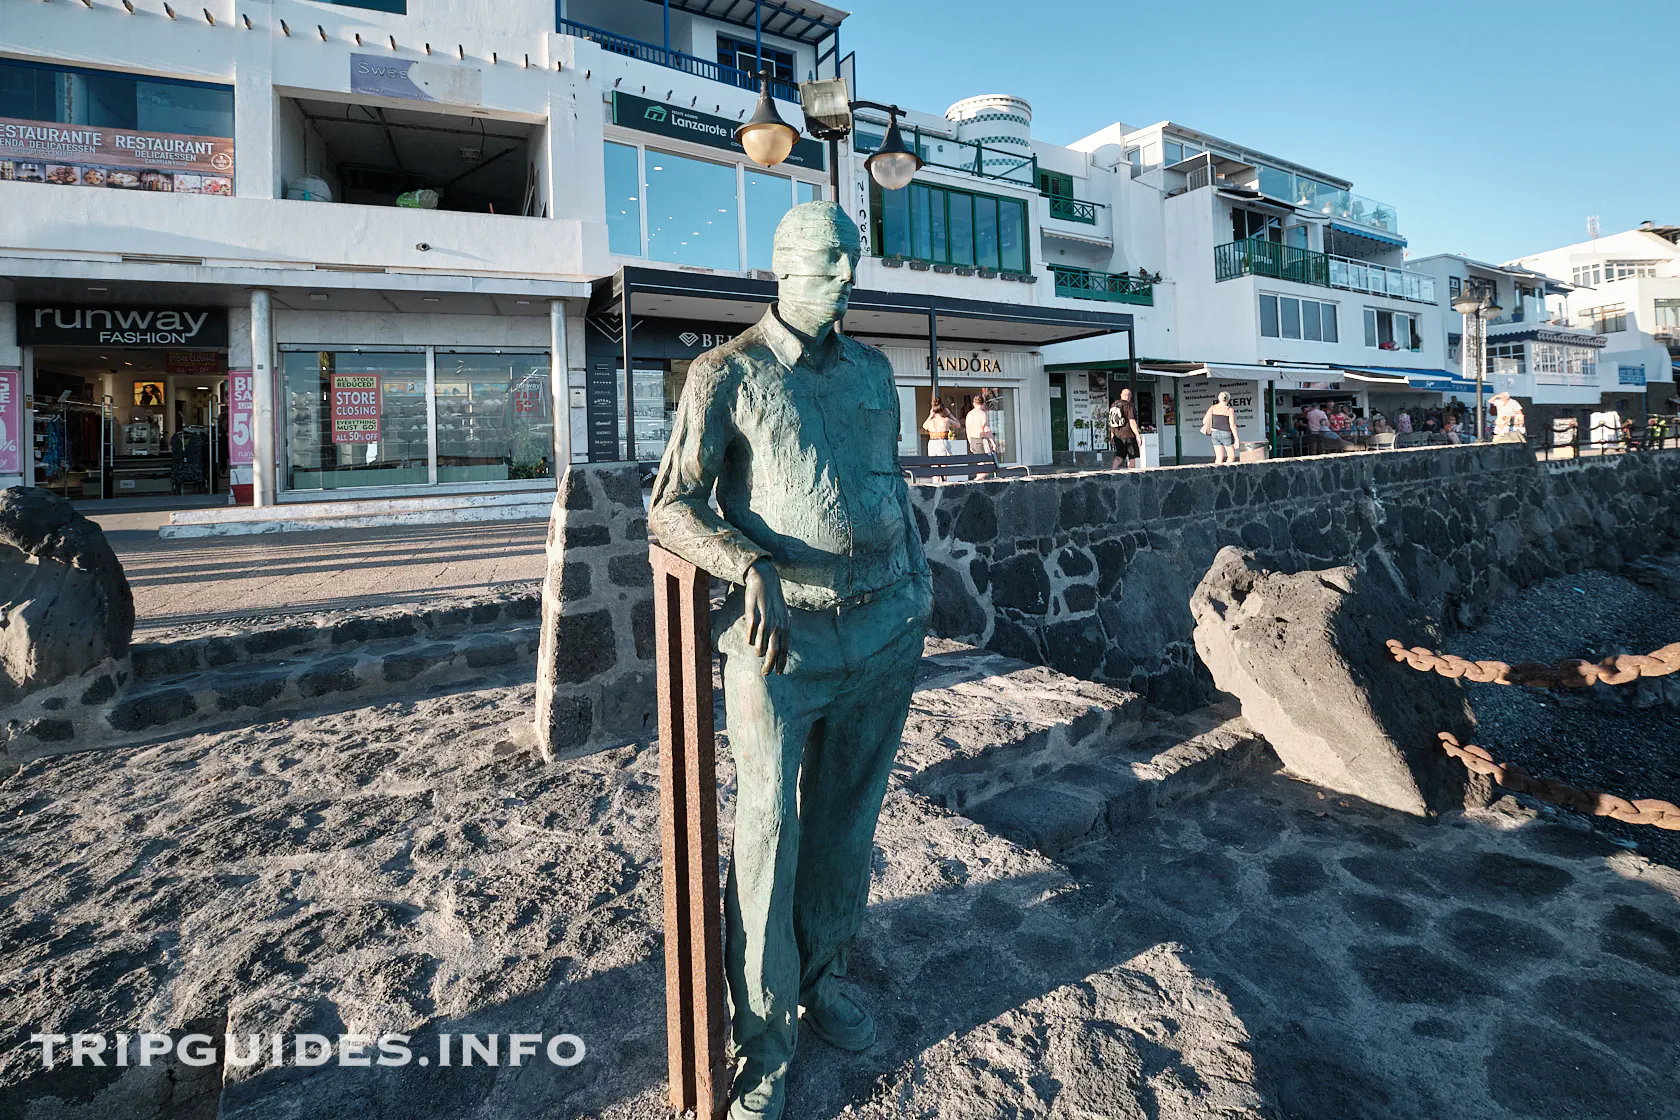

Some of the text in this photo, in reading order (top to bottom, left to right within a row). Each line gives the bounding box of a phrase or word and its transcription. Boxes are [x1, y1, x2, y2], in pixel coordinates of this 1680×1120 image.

[672, 114, 727, 137] Lanzarote
[29, 141, 96, 154] DELICATESSEN
[115, 135, 214, 155] RESTAURANT
[135, 150, 197, 162] DELICATESSEN
[35, 308, 208, 337] runway
[100, 331, 186, 344] FASHION
[336, 391, 376, 405] STORE
[336, 406, 377, 416] CLOSING
